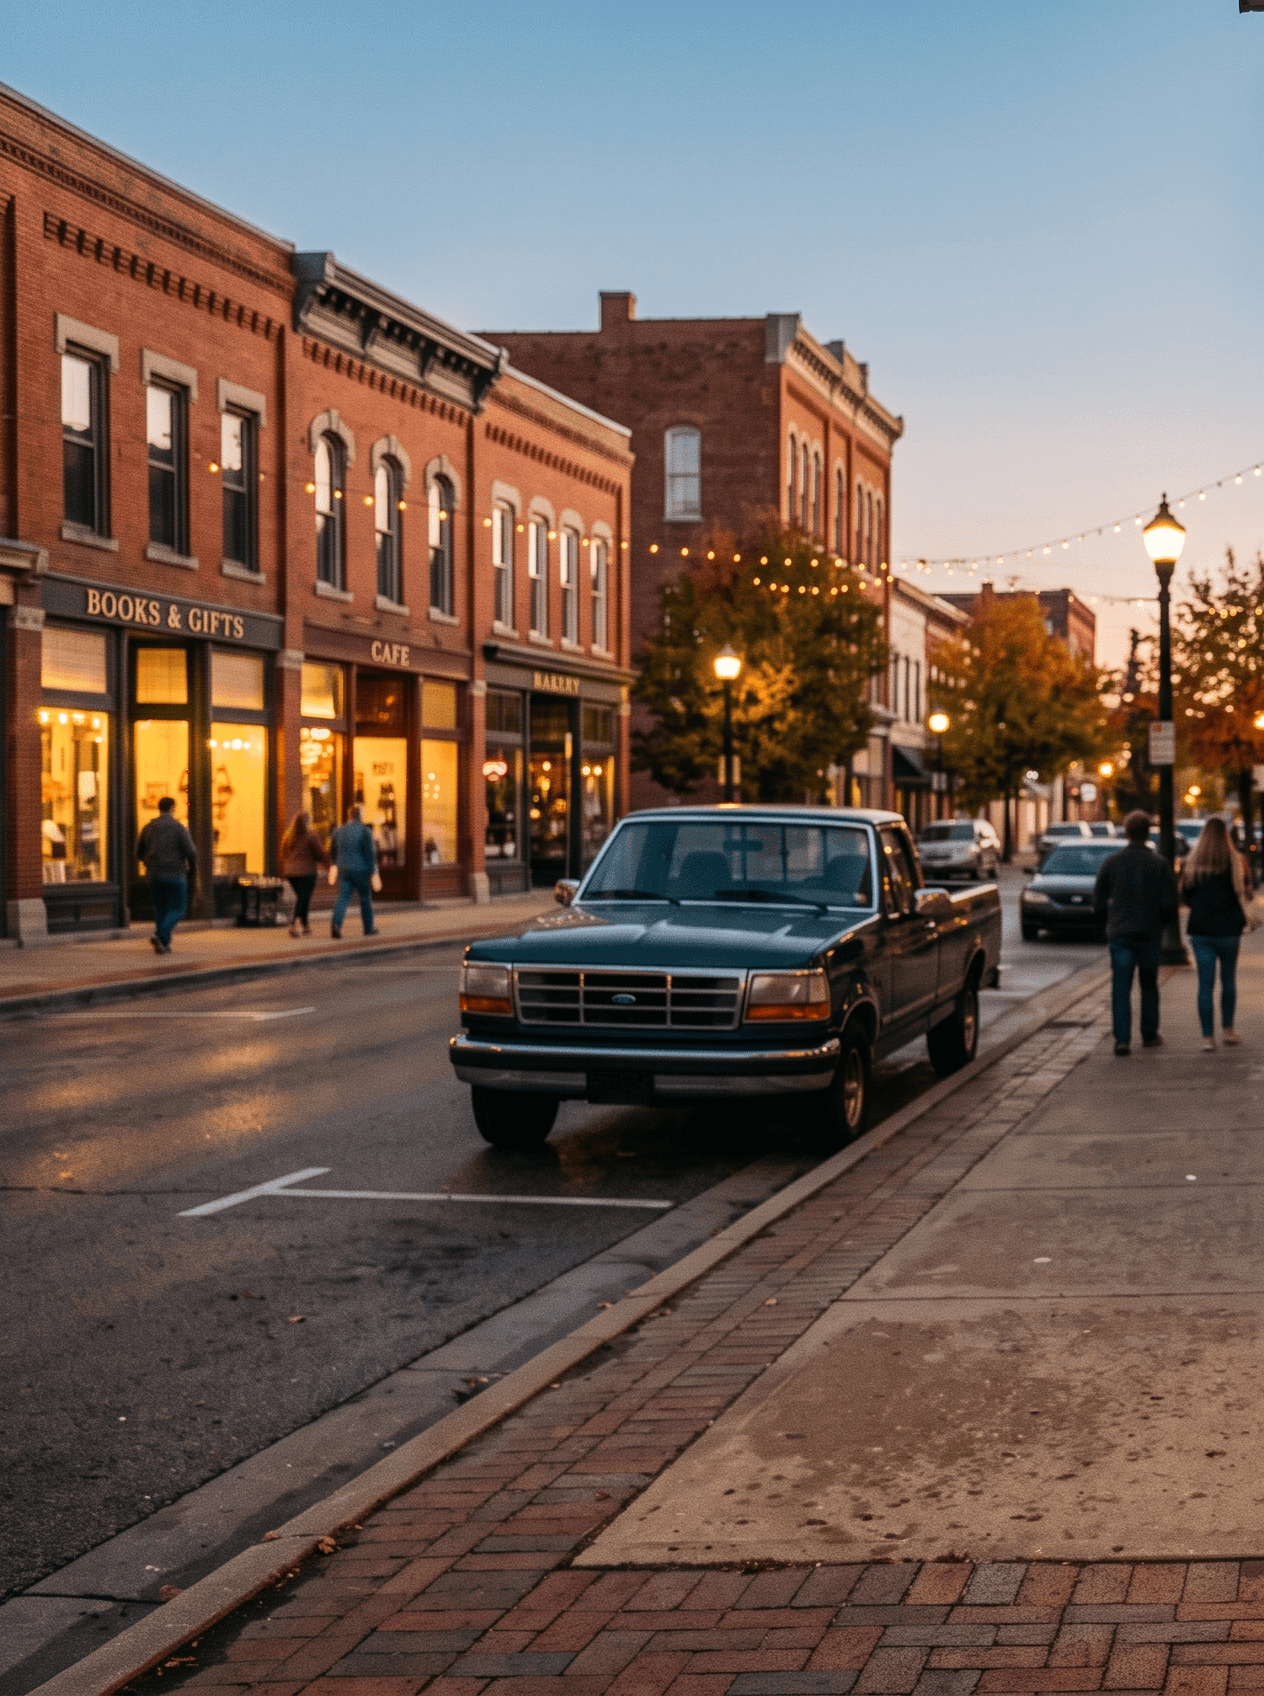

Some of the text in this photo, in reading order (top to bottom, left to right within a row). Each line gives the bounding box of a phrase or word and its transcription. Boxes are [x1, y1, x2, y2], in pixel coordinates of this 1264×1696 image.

[87, 588, 244, 639] BOOKS & GIFTS
[371, 640, 410, 666] CAFE
